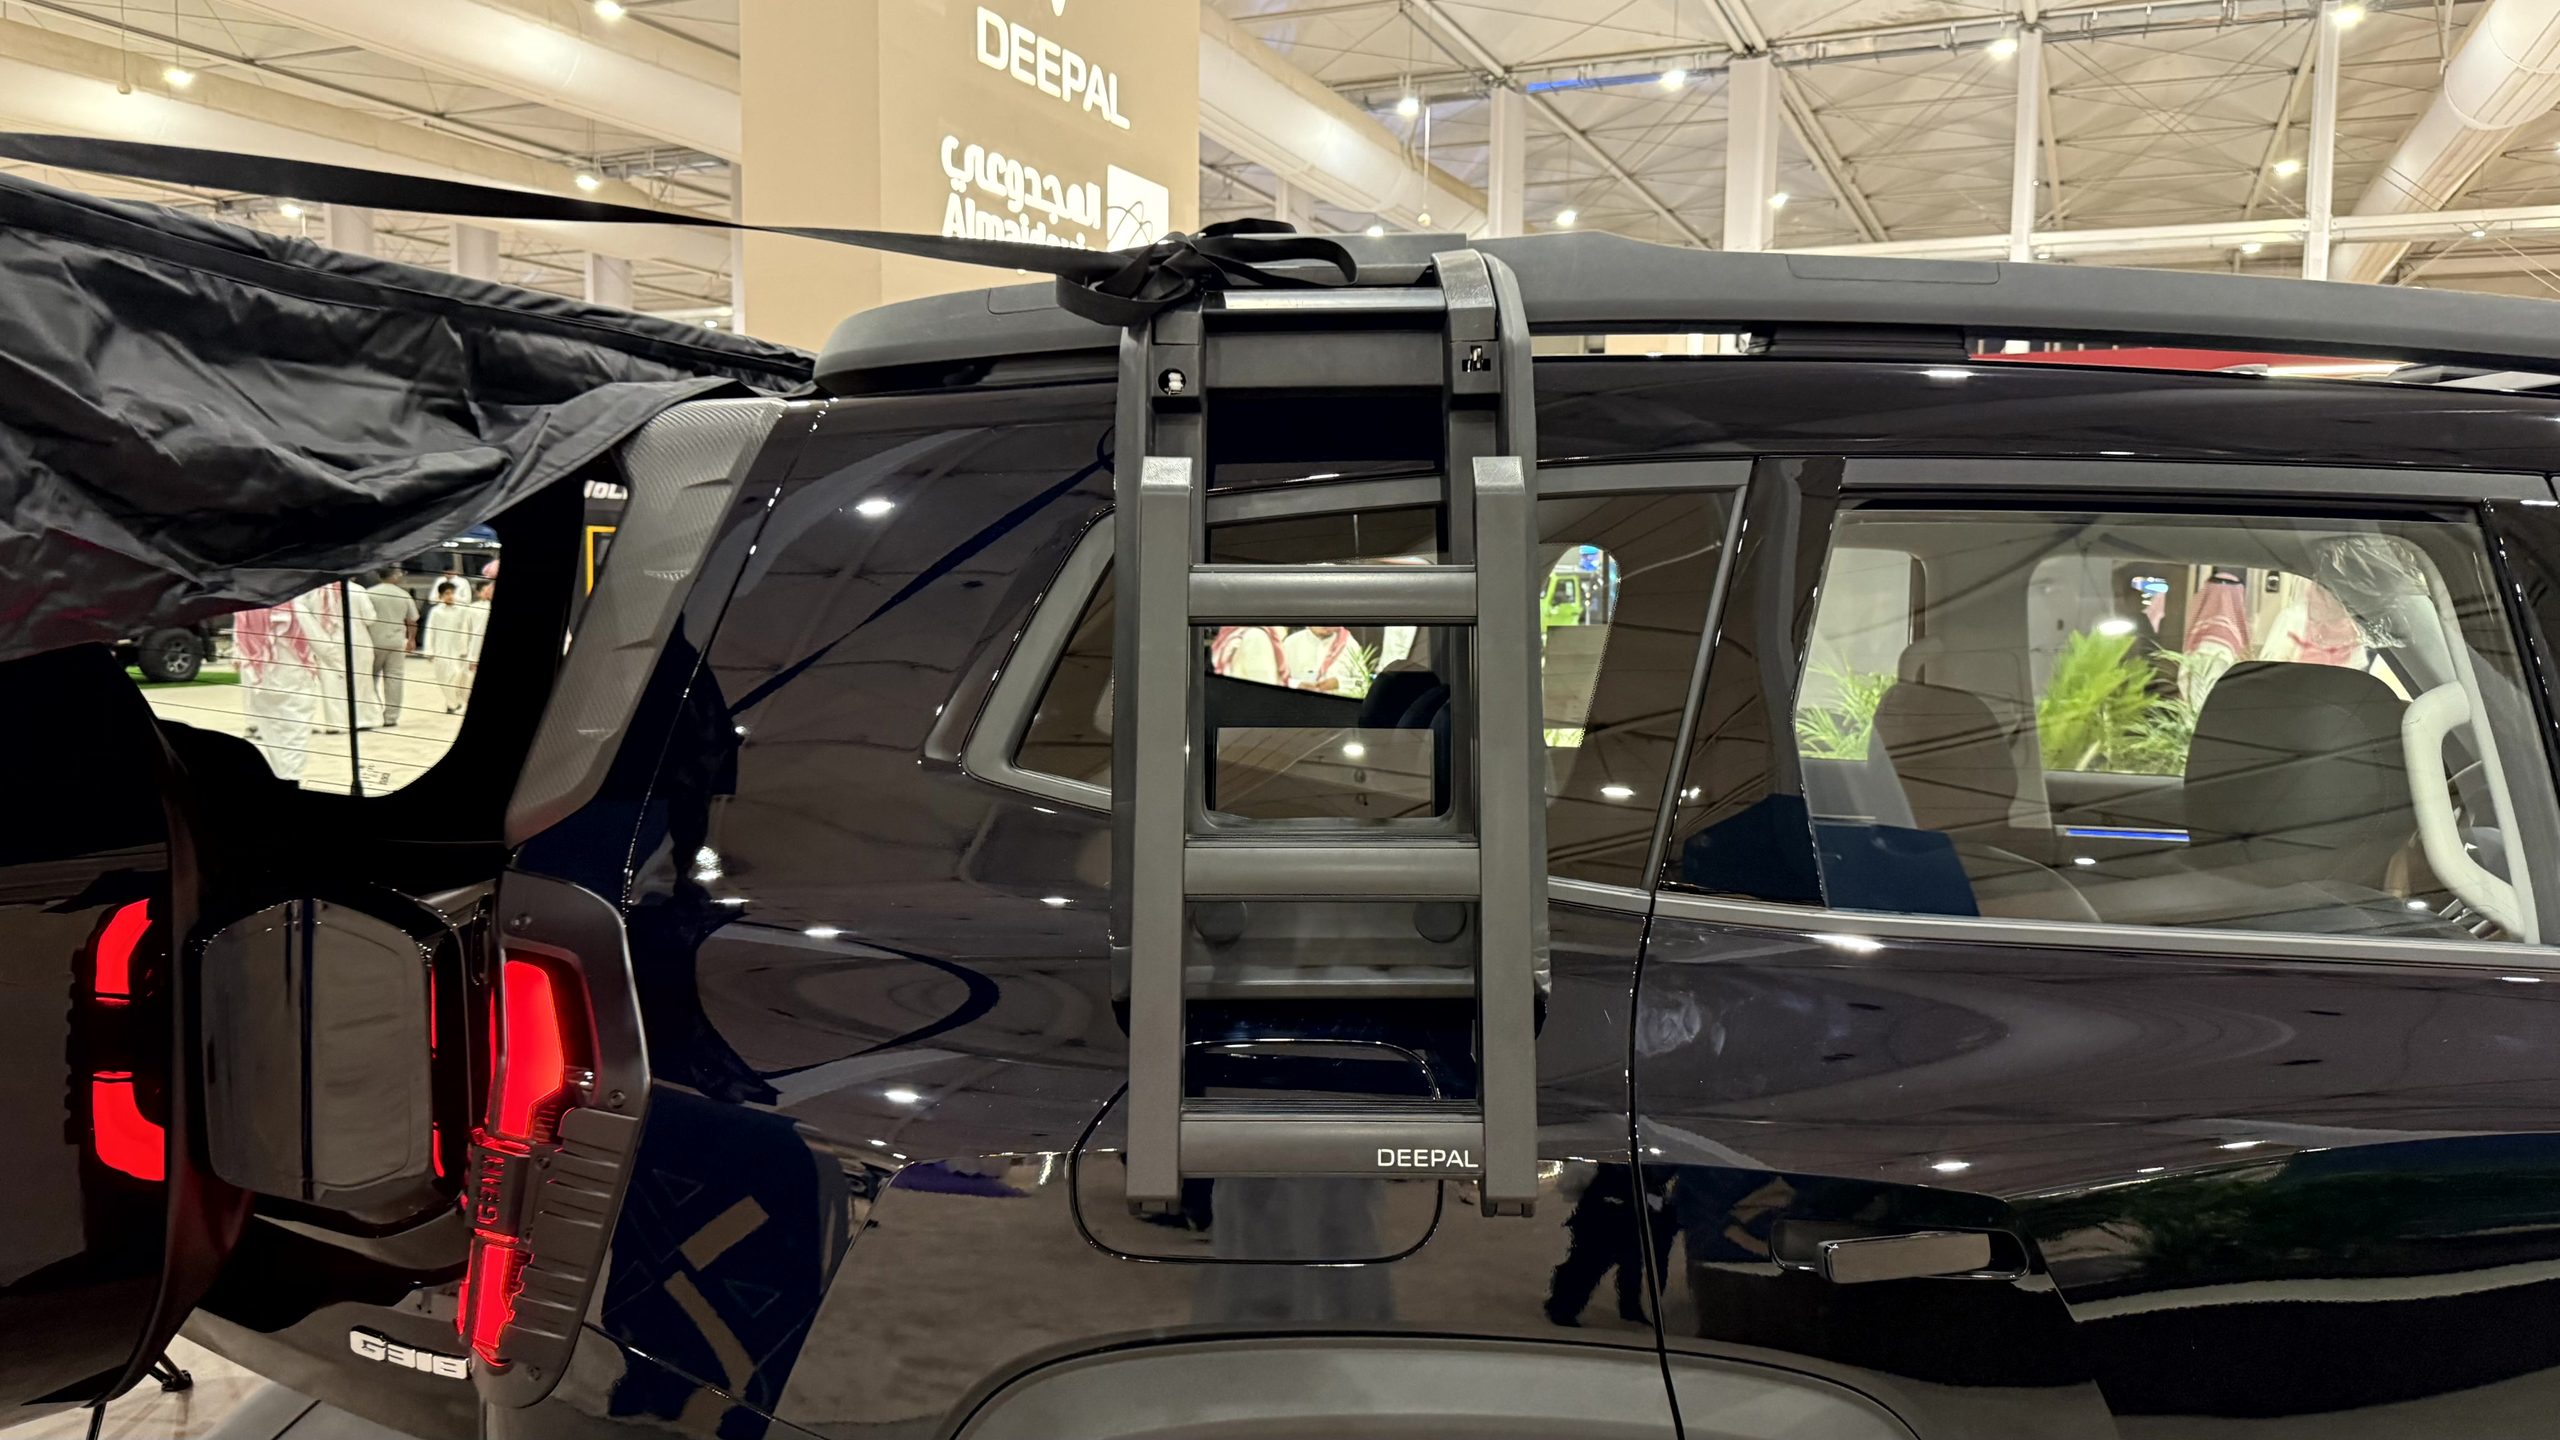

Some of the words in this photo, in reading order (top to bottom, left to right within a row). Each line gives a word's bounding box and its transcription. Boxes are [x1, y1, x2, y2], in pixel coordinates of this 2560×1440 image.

[976, 6, 1131, 130] DEEPAL
[940, 134, 1101, 230] المجدوعي
[1377, 1148, 1479, 1168] DEEPAL
[349, 1328, 470, 1380] G318
